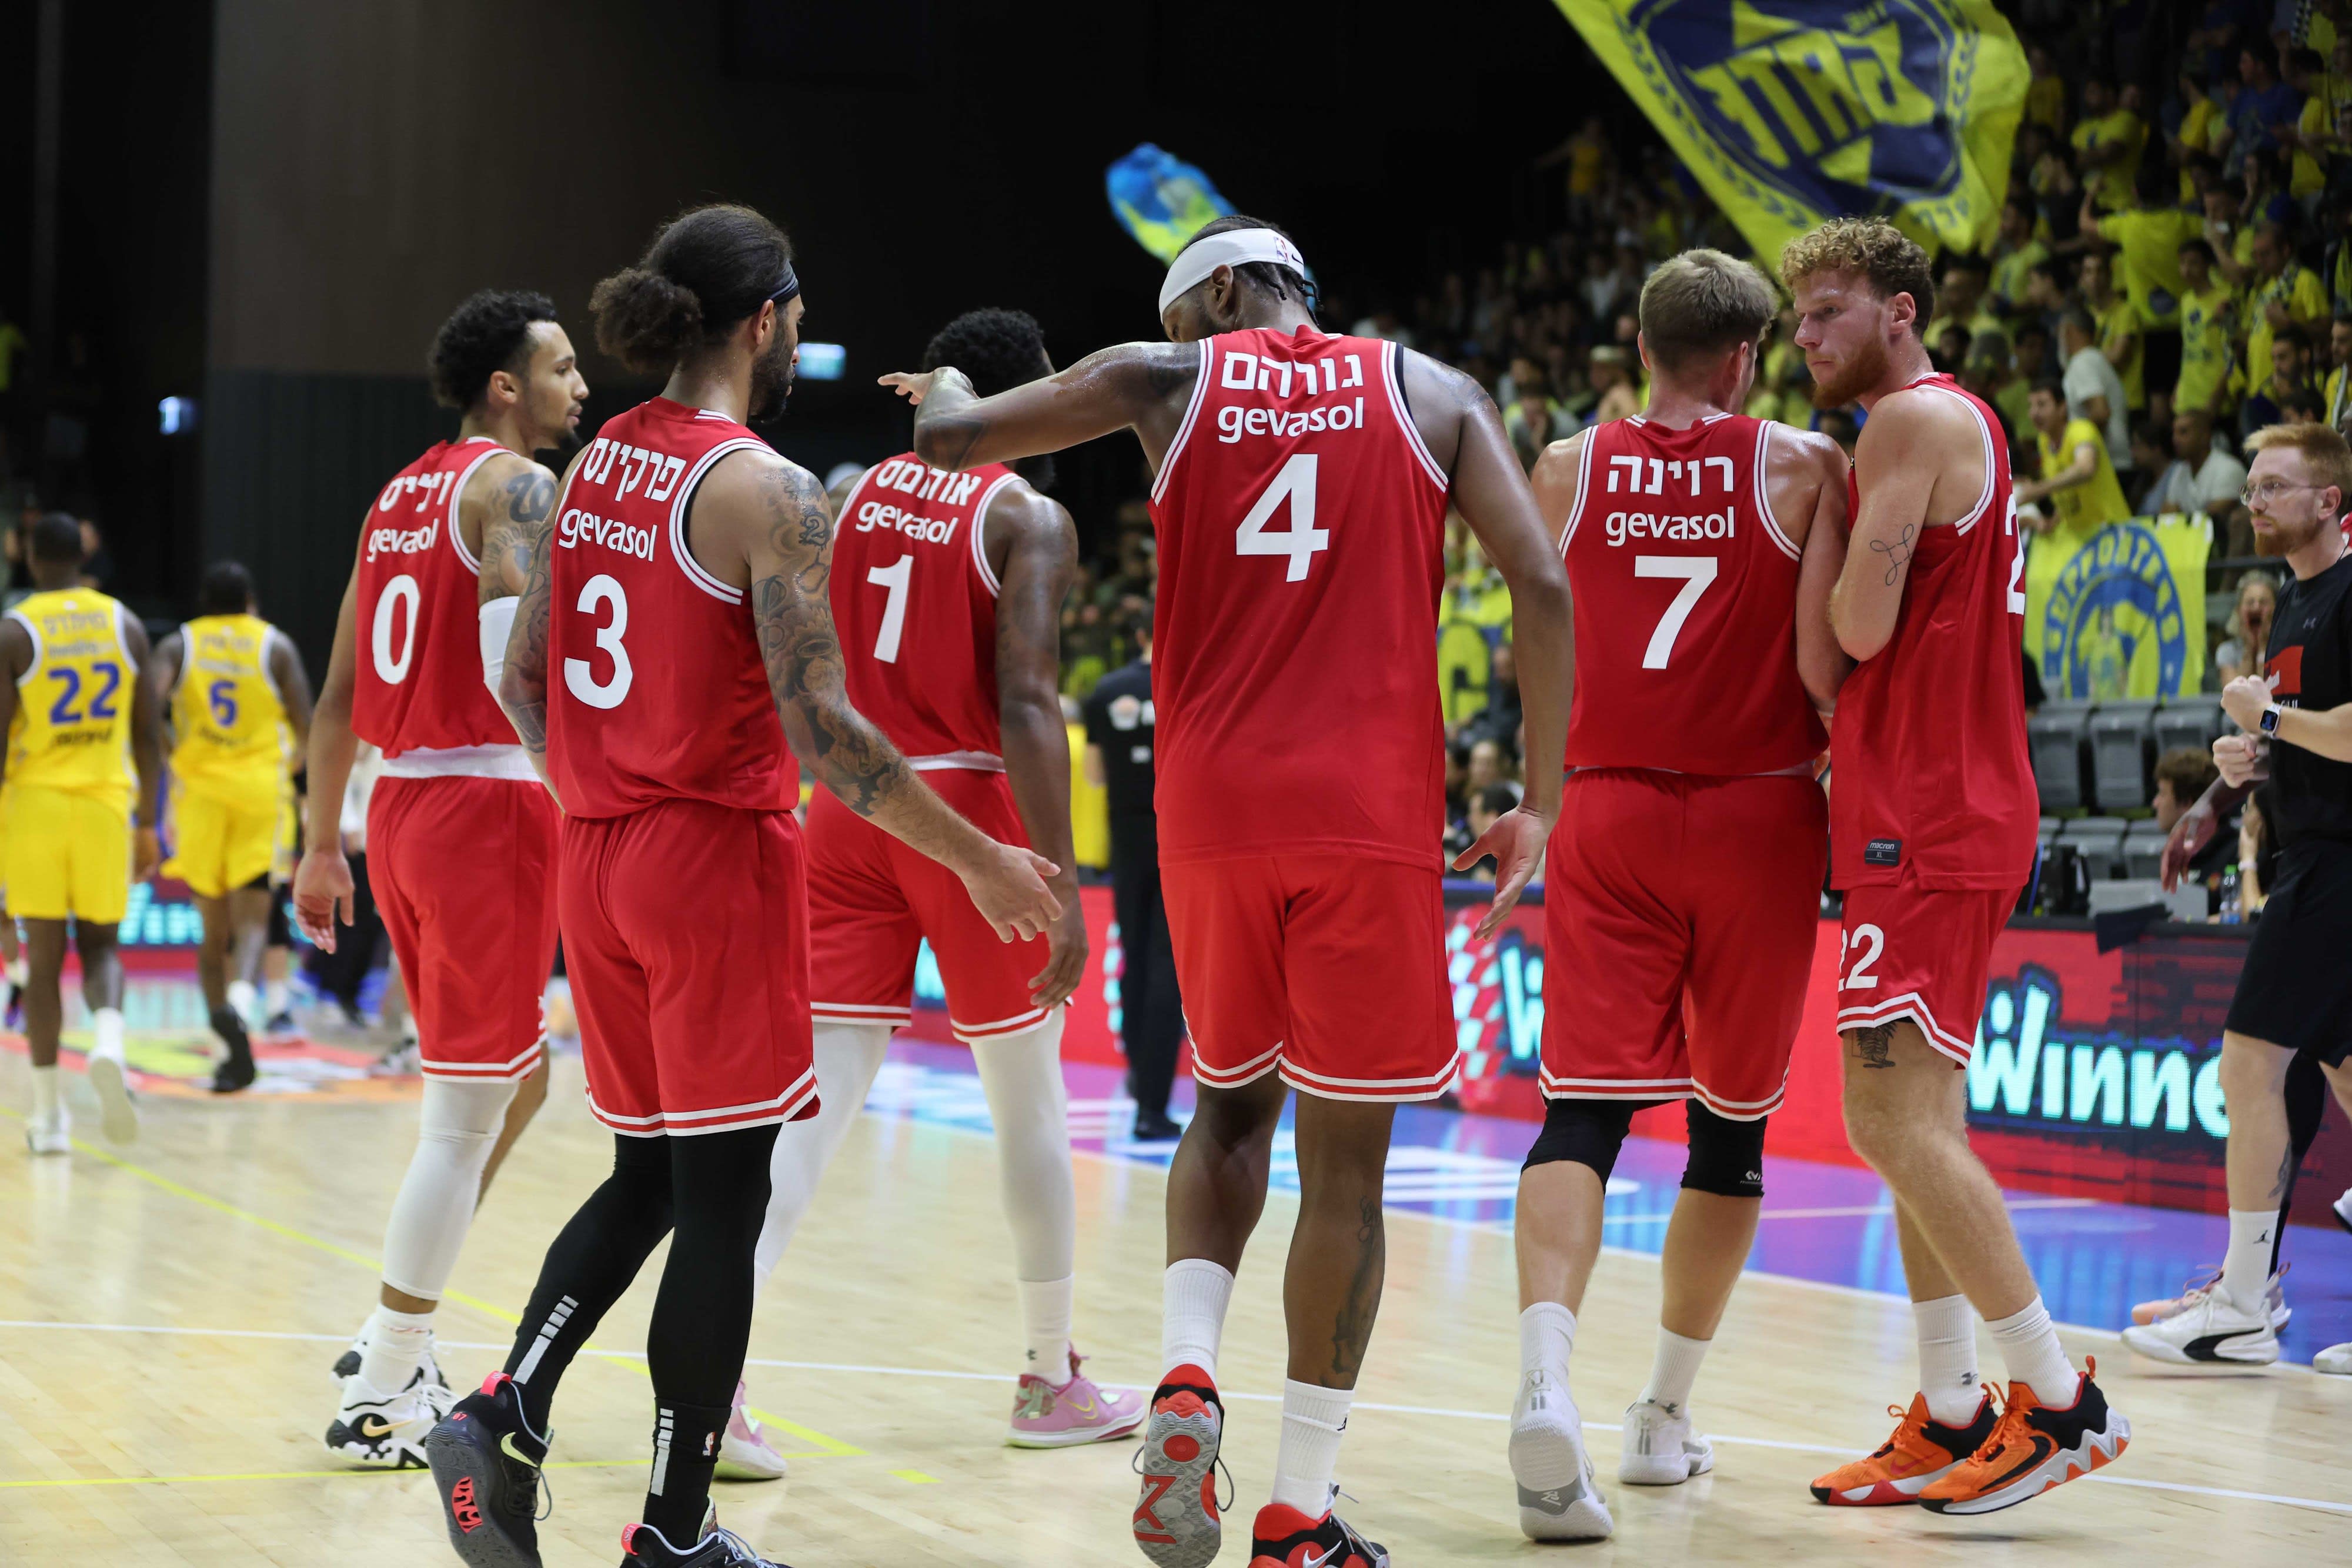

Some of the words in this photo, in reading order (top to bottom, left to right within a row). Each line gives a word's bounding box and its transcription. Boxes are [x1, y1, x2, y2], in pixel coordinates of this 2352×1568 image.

[1221, 351, 1364, 397] גורהם
[1218, 397, 1364, 444] gevasol
[583, 437, 687, 502] פרקינס
[1607, 456, 1733, 496] רוינה
[366, 518, 440, 563] gevaol
[558, 508, 657, 561] gevasol
[1236, 453, 1329, 582] 4
[1606, 506, 1734, 547] gevasol
[372, 574, 420, 684] 0
[867, 554, 914, 664] 1
[1635, 556, 1718, 669] 7
[564, 574, 633, 708] 3
[48, 663, 119, 723] 22
[1870, 842, 1895, 850] macron
